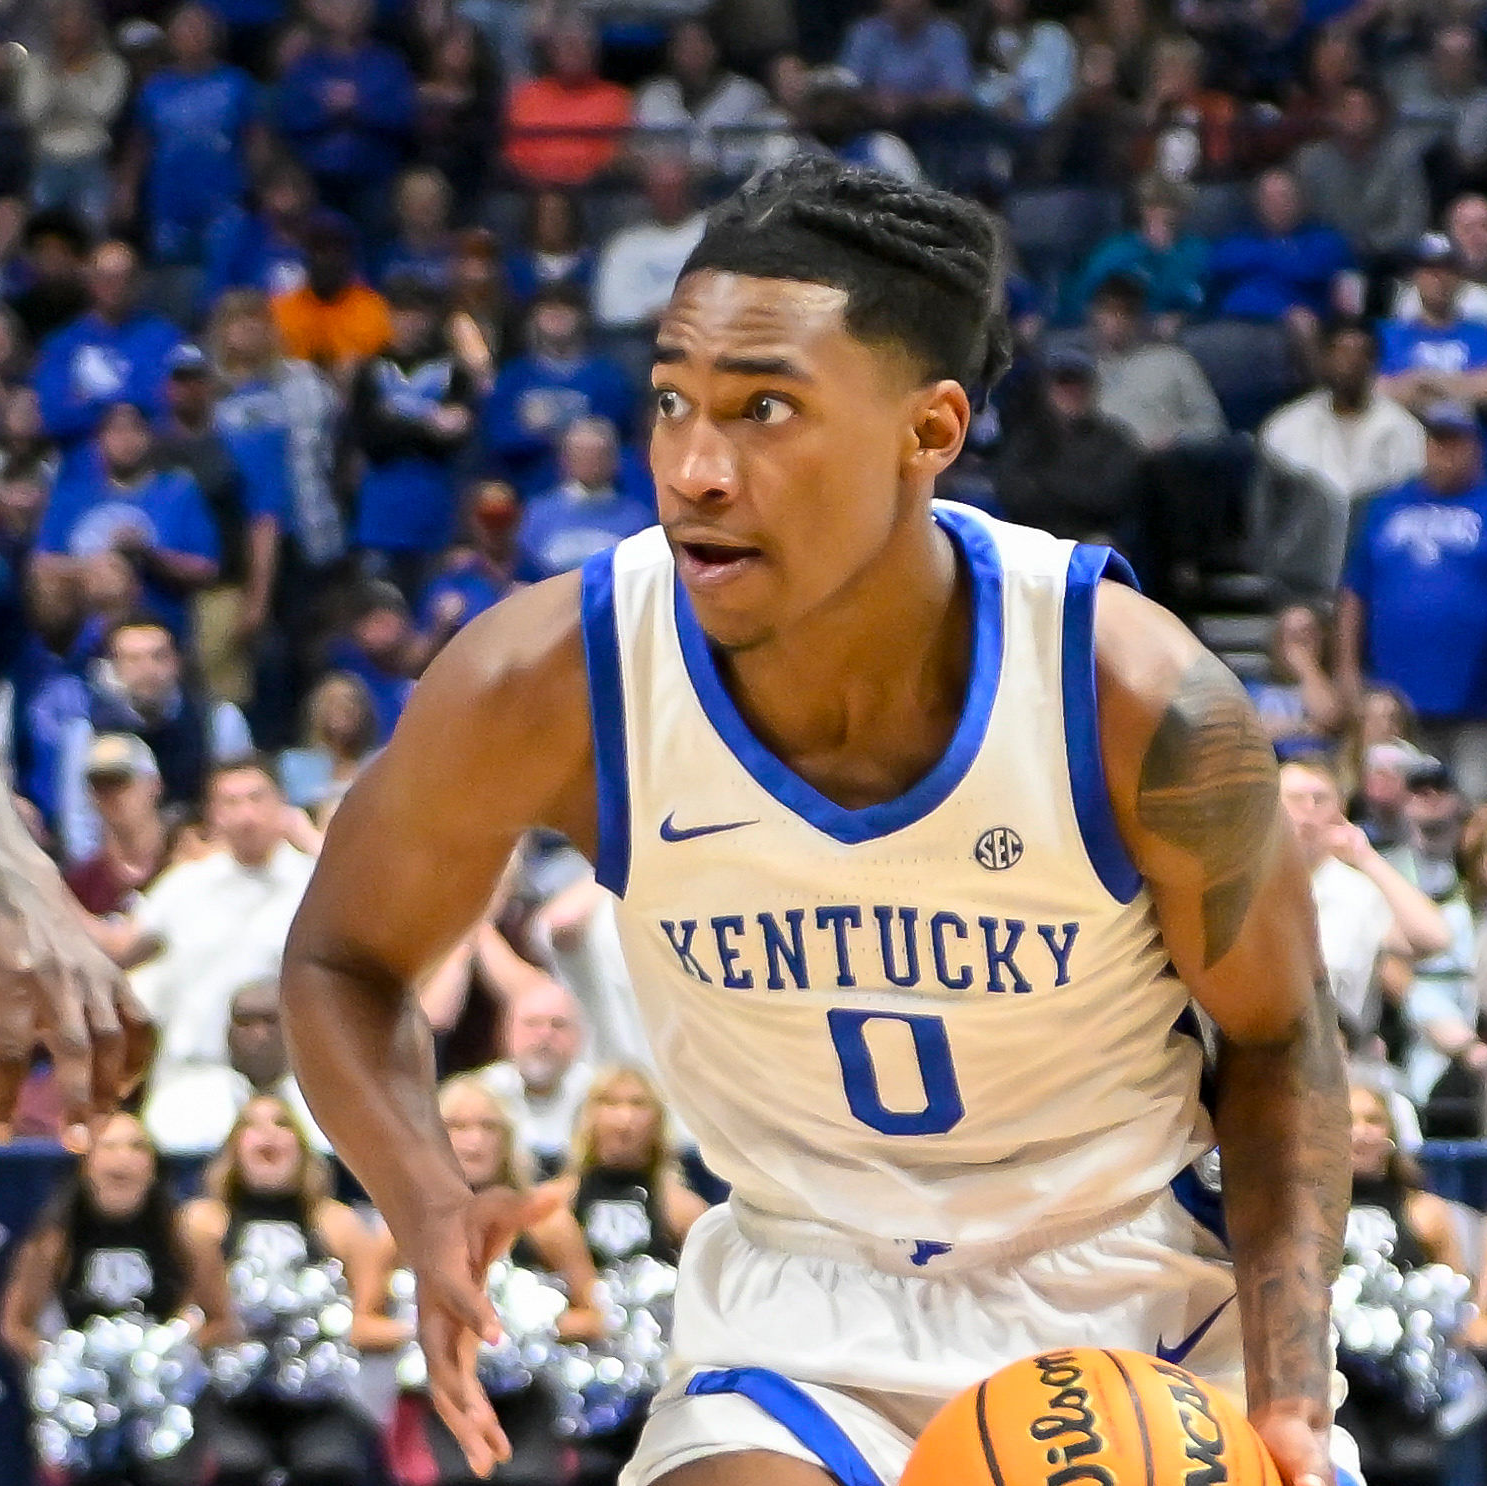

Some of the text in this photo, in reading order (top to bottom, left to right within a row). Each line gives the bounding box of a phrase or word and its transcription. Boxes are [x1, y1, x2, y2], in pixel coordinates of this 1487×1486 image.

[977, 828, 1023, 868] SEC
[660, 904, 1080, 994] KENTUCKY
[826, 1006, 966, 1136] 0
